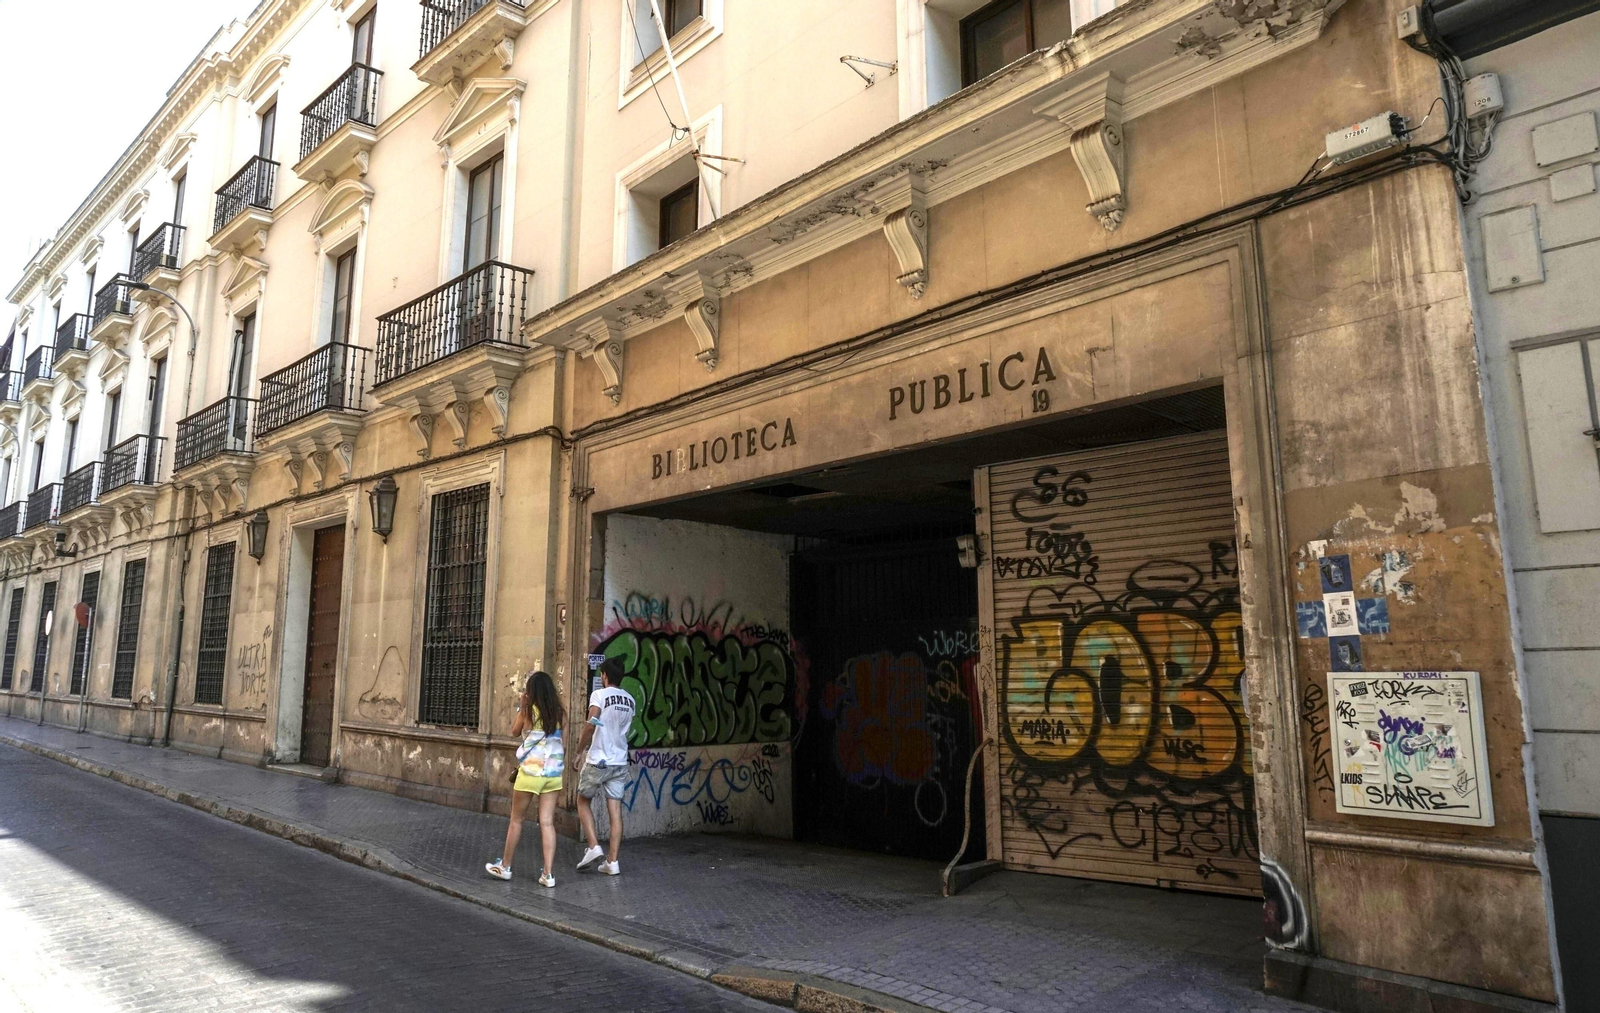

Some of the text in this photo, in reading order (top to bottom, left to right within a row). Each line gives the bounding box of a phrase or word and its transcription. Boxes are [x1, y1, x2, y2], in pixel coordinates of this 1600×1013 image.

[1344, 126, 1369, 140] 572867
[651, 346, 1057, 480] BIBLIOTECA PUBLICA
[1031, 388, 1051, 412] 19
[238, 642, 267, 670] ULTRA
